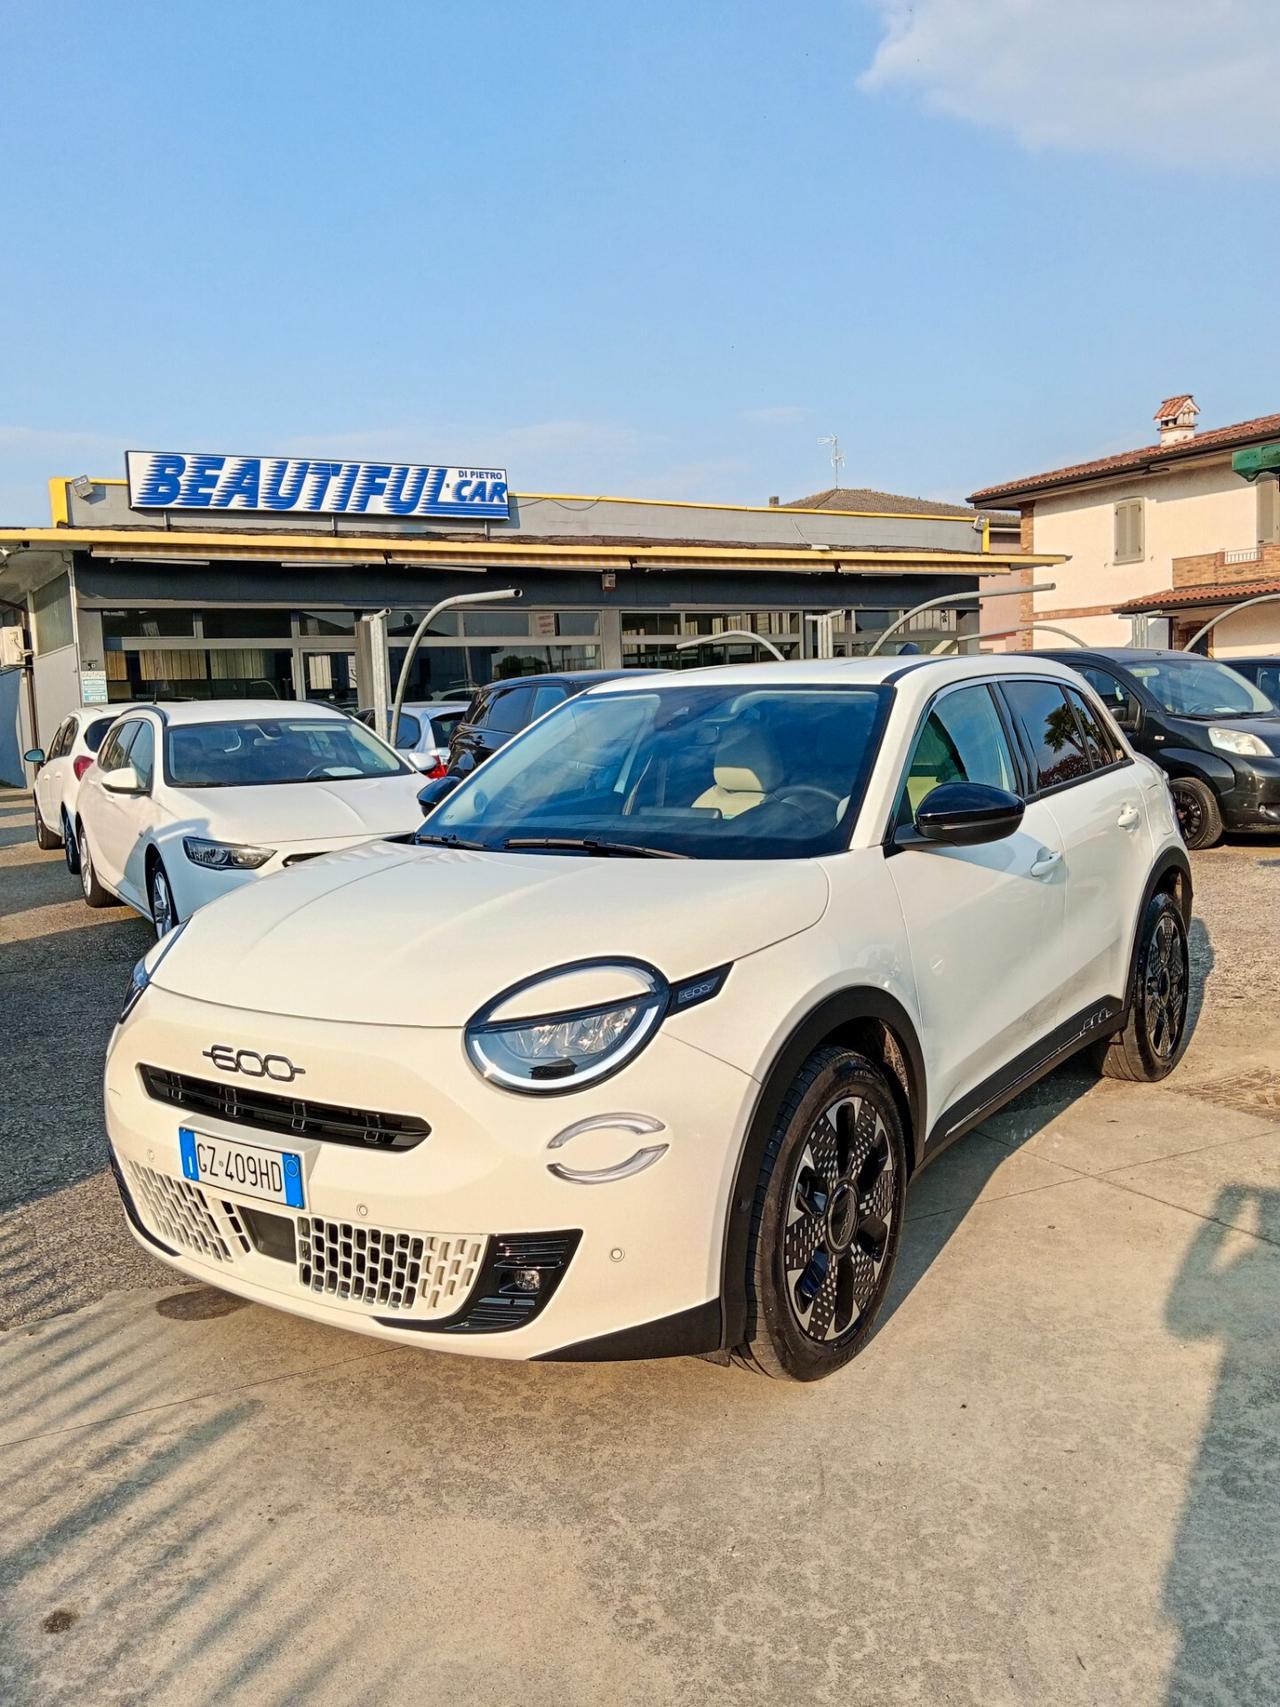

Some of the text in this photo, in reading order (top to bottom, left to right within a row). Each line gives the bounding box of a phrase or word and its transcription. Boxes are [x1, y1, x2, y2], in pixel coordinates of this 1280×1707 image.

[135, 454, 448, 515] BEAUTIFUL
[458, 470, 503, 480] DI PIETRO
[453, 480, 507, 502] CAR
